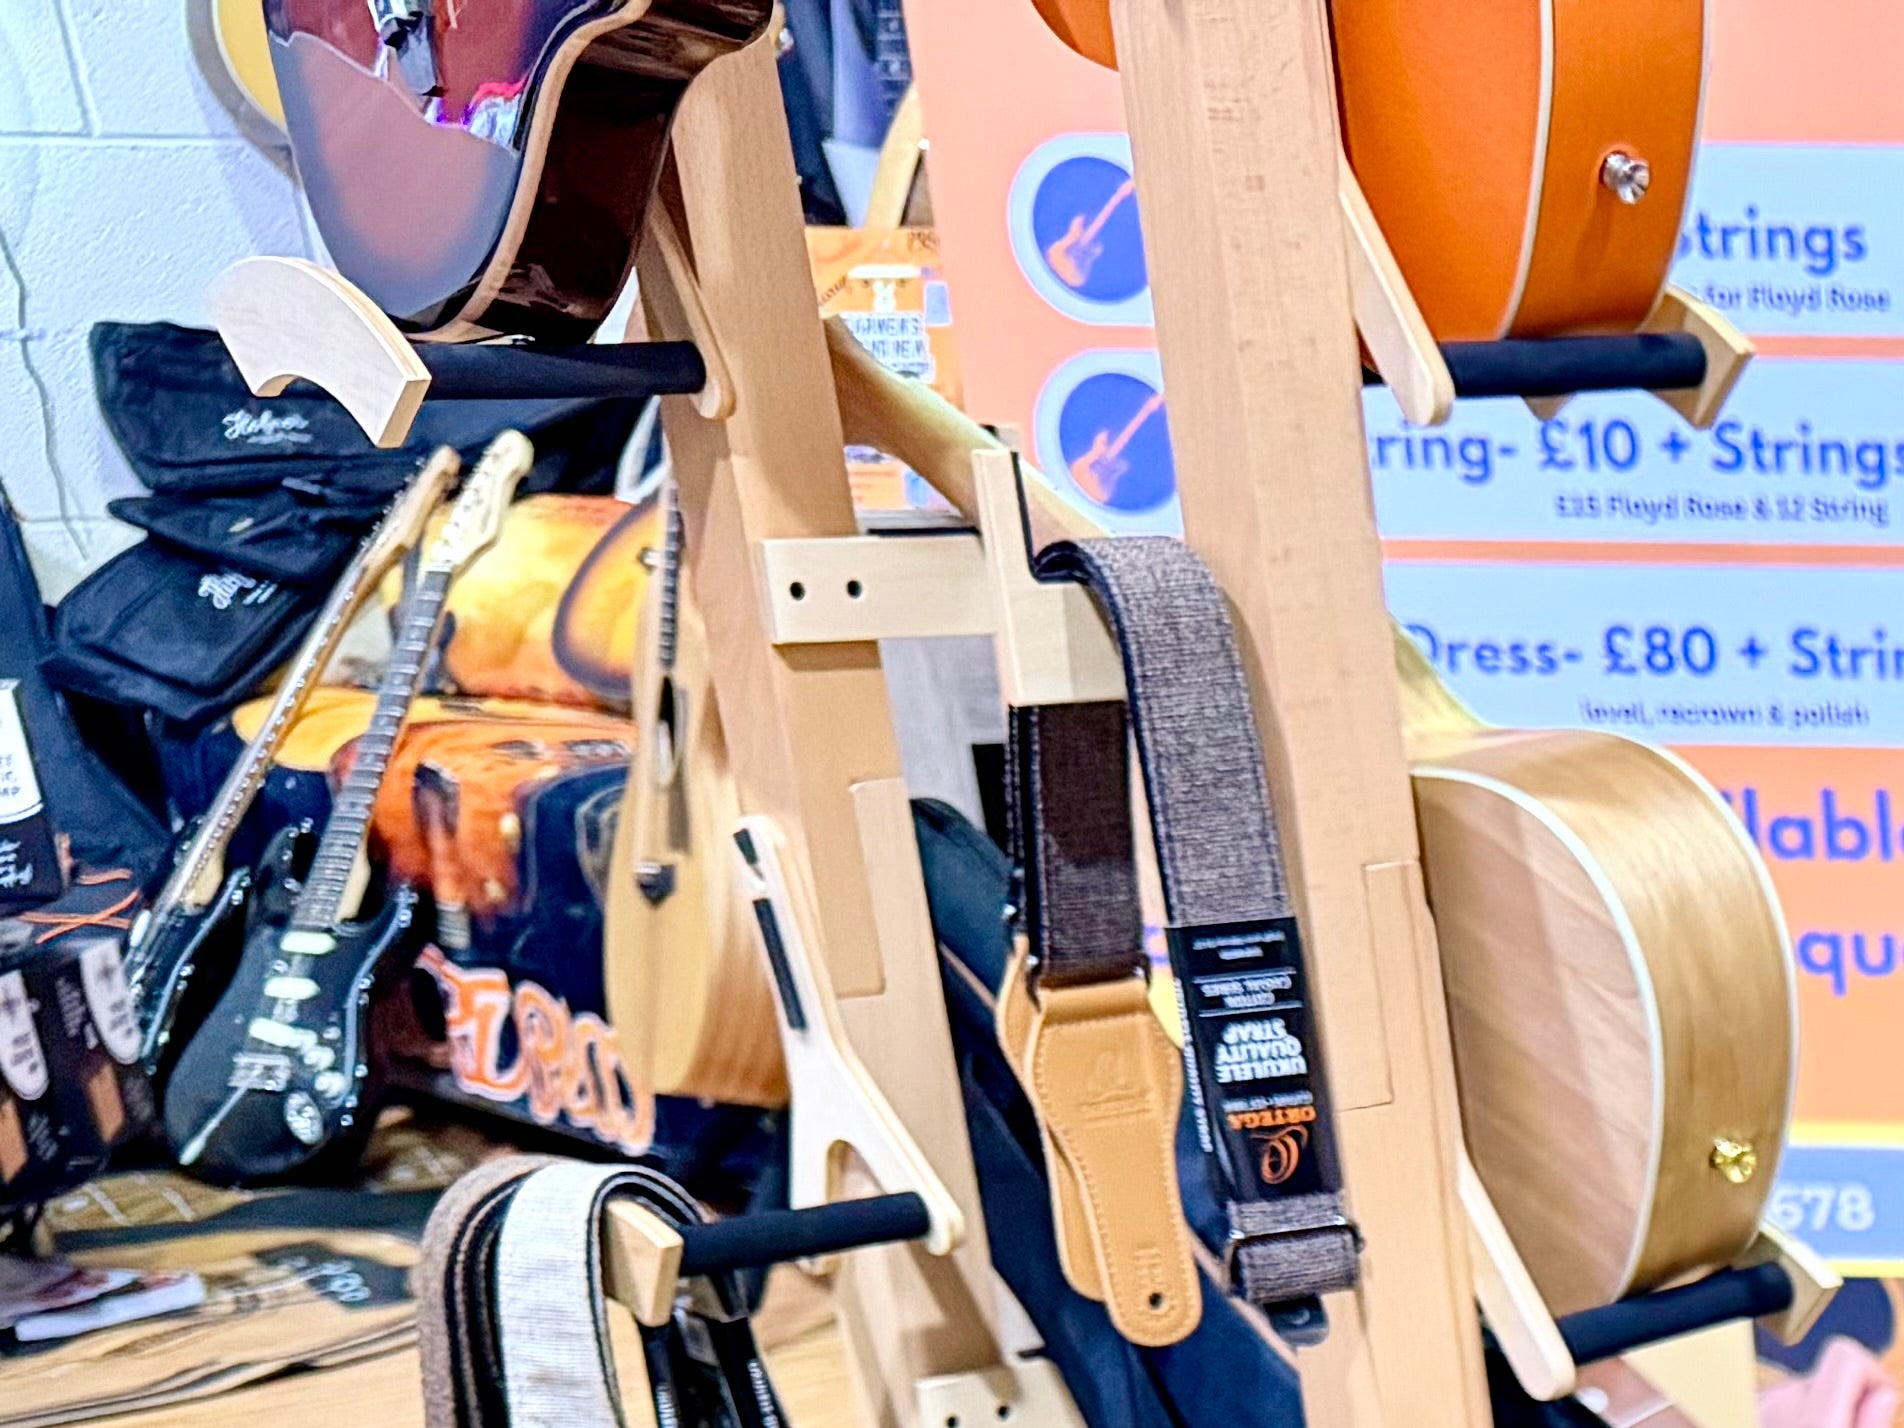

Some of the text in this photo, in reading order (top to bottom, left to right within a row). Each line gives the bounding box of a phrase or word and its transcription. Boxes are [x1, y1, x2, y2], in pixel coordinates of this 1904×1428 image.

[1748, 283, 1821, 318] Floyd
[1827, 285, 1891, 312] Rose
[1371, 419, 1517, 485] ring-
[1538, 418, 1638, 472] £10
[1657, 429, 1690, 464] +
[1608, 493, 1679, 526] Floyd
[1686, 494, 1746, 521] Rose
[1752, 496, 1770, 521] &
[1811, 496, 1890, 528] String
[1604, 625, 1717, 677] £80
[1738, 636, 1768, 669] +
[1791, 702, 1870, 731] polish
[1222, 1017, 1288, 1046] STRAP
[1215, 1036, 1303, 1065] QUALITY
[1215, 1055, 1308, 1084] UKULELE
[1226, 1104, 1317, 1131] ORTEGA
